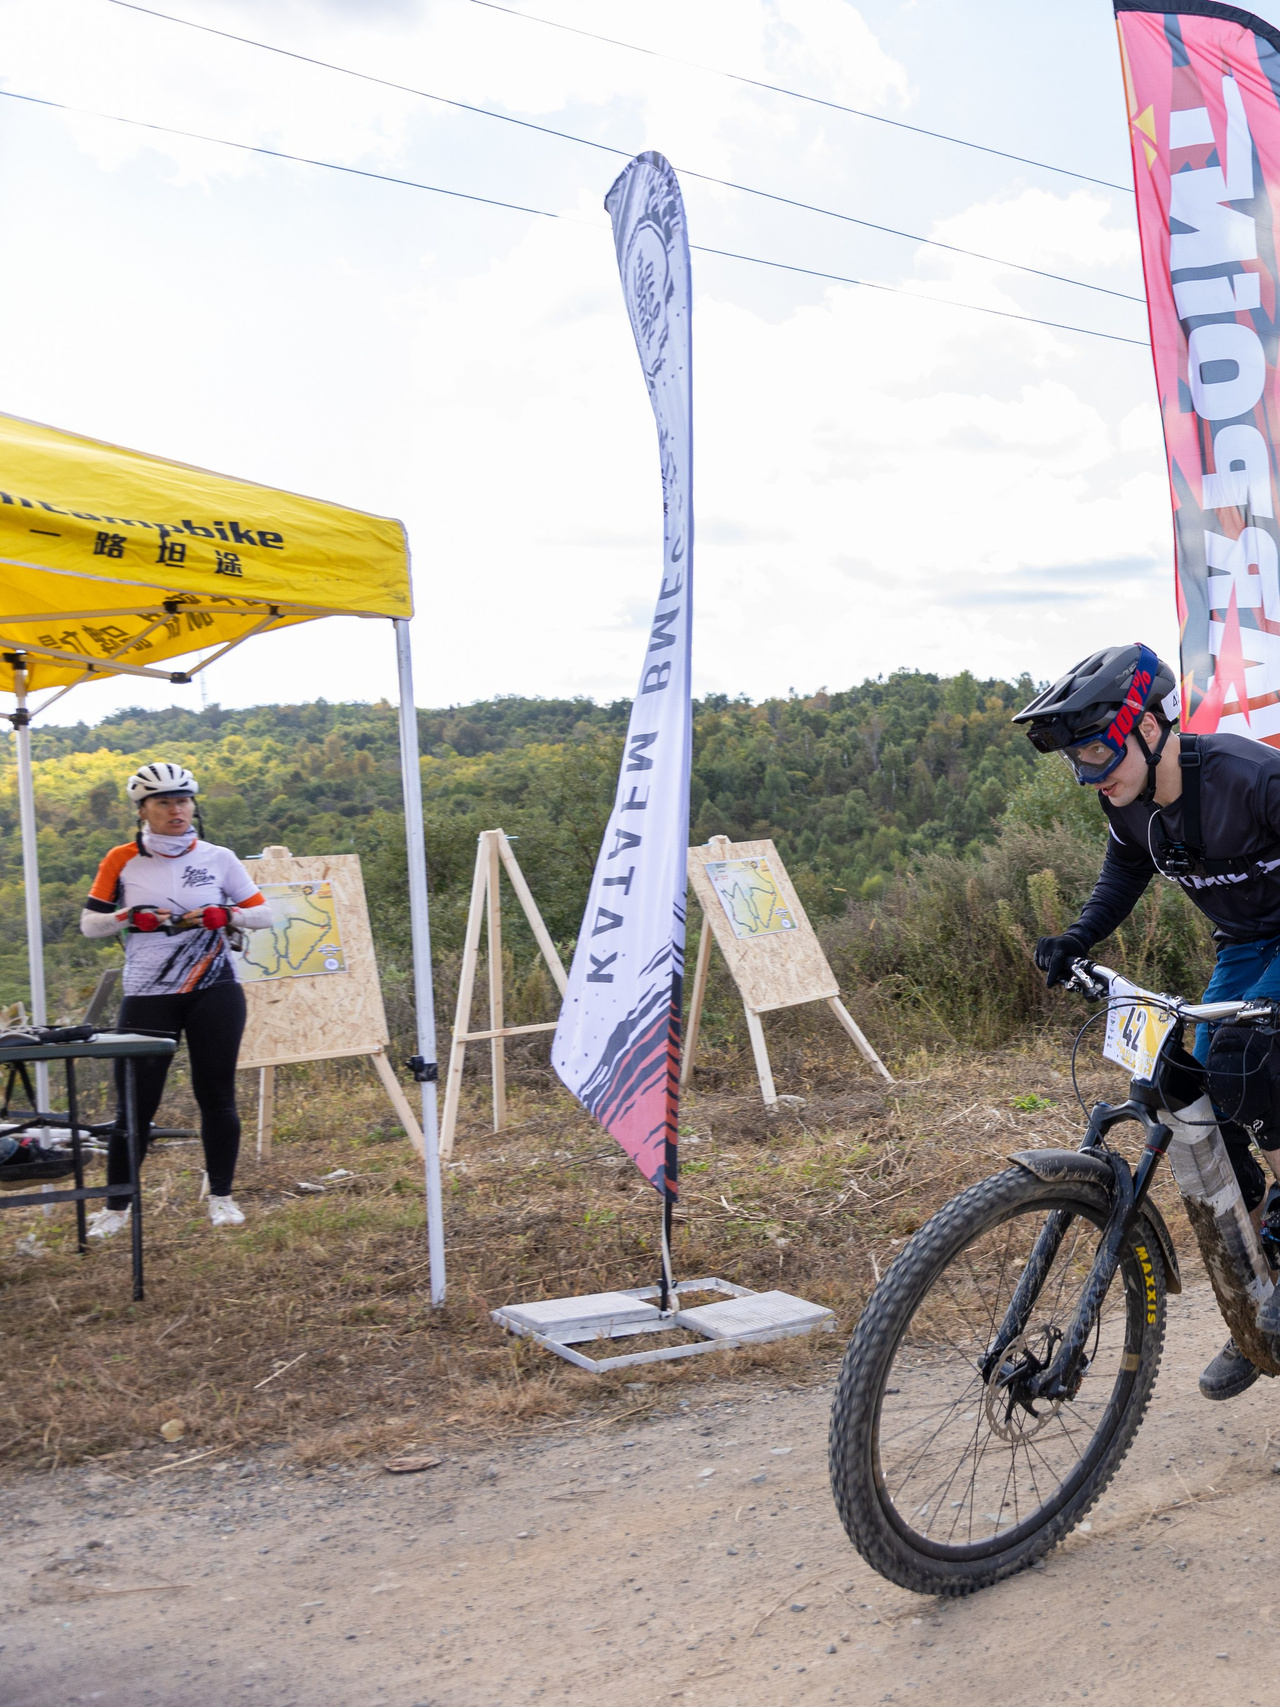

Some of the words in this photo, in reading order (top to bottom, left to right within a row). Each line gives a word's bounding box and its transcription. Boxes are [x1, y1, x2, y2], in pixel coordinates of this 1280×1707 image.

[1115, 660, 1139, 679] ME
[1107, 669, 1151, 748] 100%
[1122, 1006, 1147, 1052] 42
[1135, 1246, 1157, 1325] MAXXIS
